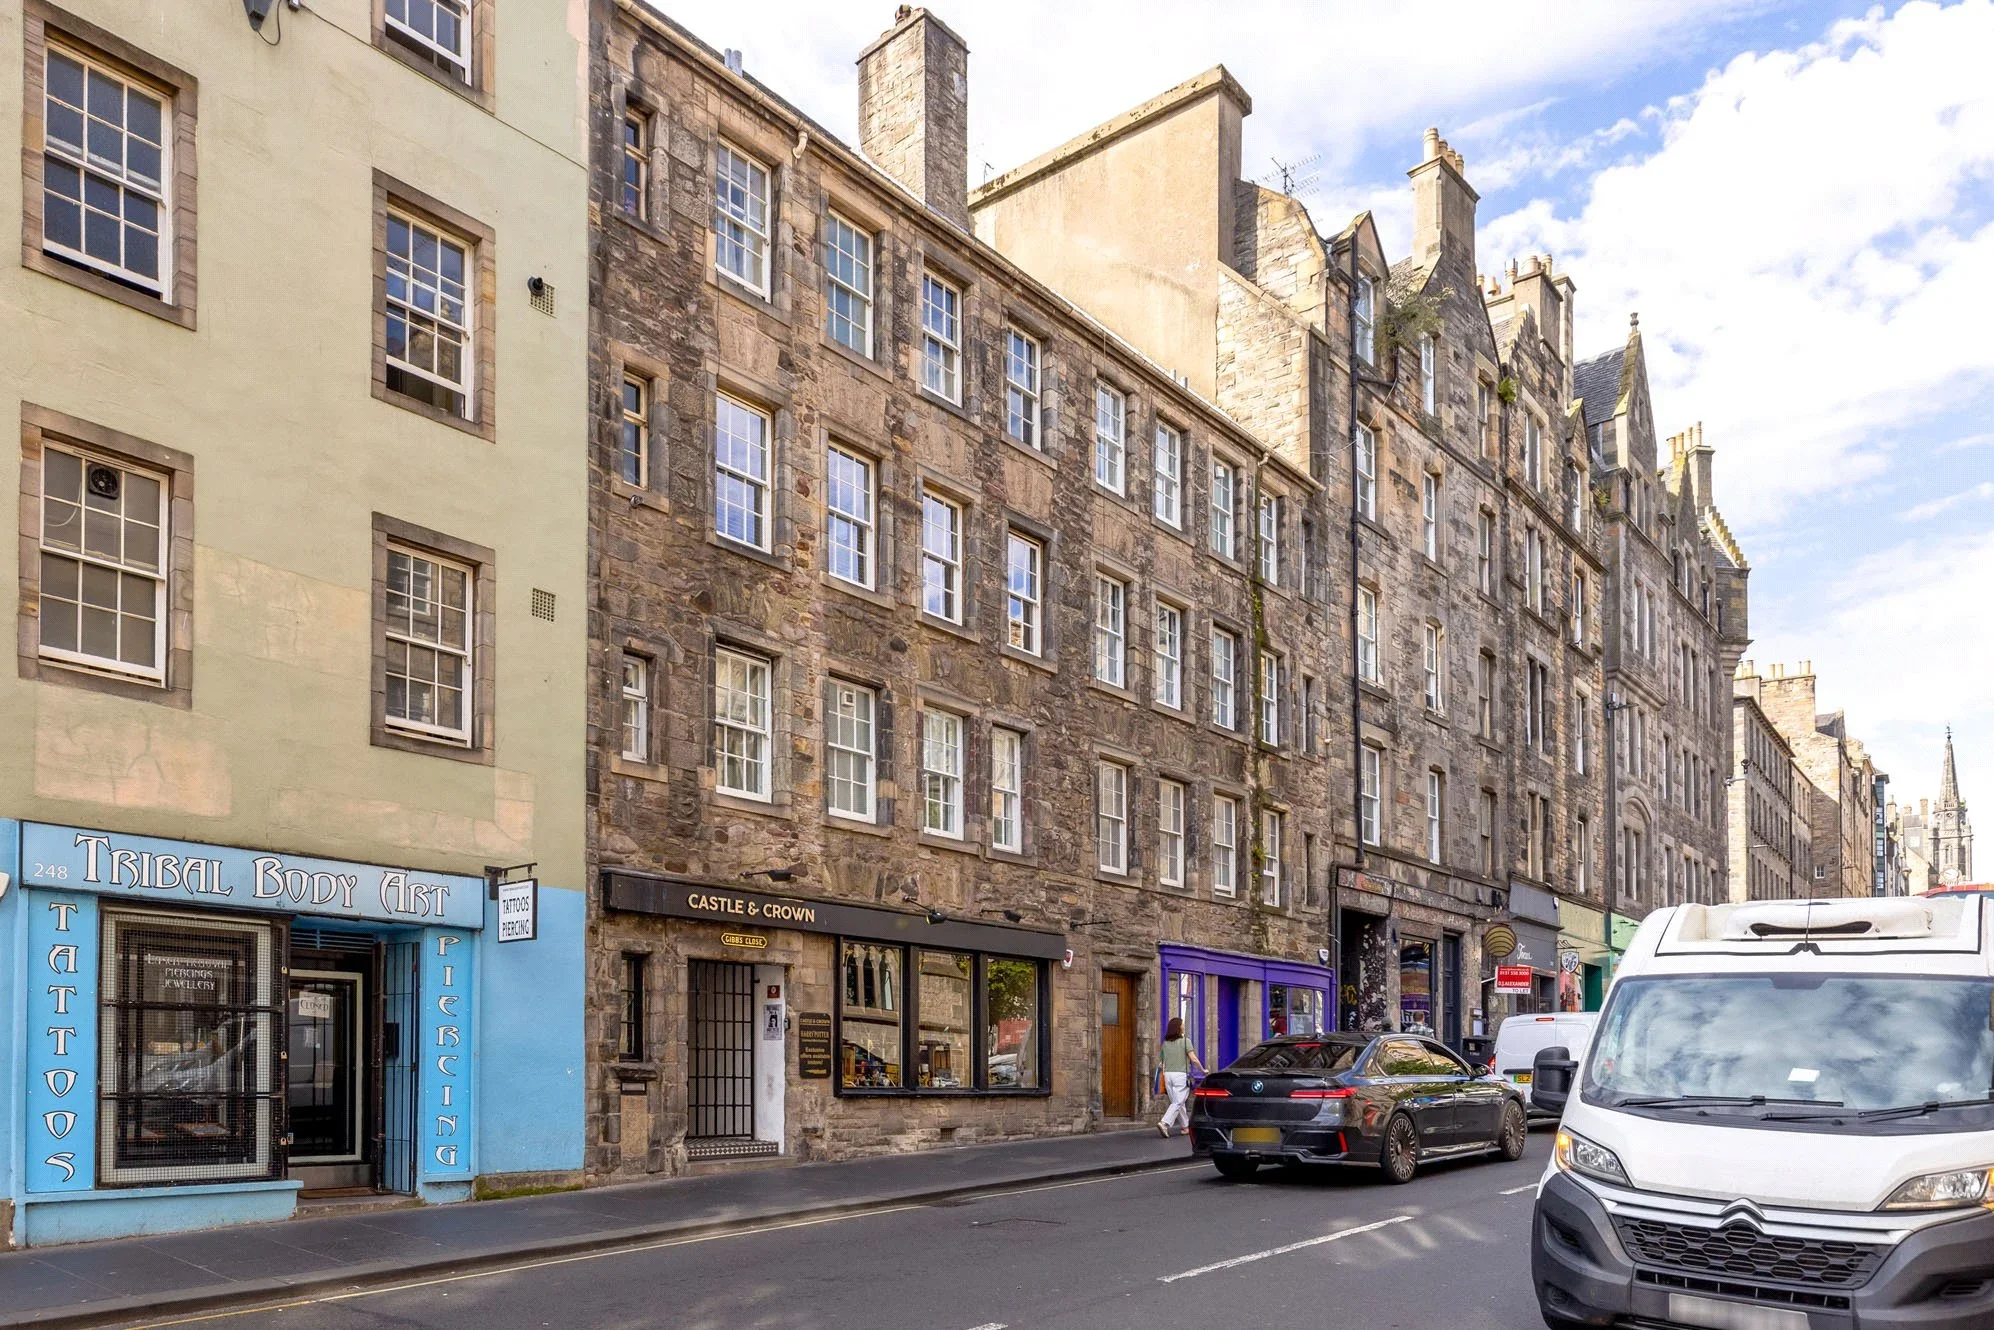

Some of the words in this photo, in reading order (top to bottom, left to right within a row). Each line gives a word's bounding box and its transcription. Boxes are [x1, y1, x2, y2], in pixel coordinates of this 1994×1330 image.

[33, 862, 68, 880] 248
[502, 895, 529, 914] TATTOOS
[688, 893, 744, 914] CASTLE
[747, 901, 760, 916] &
[762, 903, 815, 923] CROWN
[502, 919, 529, 937] PIERCING
[725, 935, 743, 944] GIBBS
[745, 937, 763, 946] CLOSE
[165, 967, 213, 979] PIERCINGS
[162, 979, 215, 990] JEWELLERY
[43, 901, 79, 1183] TATTOOS
[435, 935, 461, 1167] PIERCING
